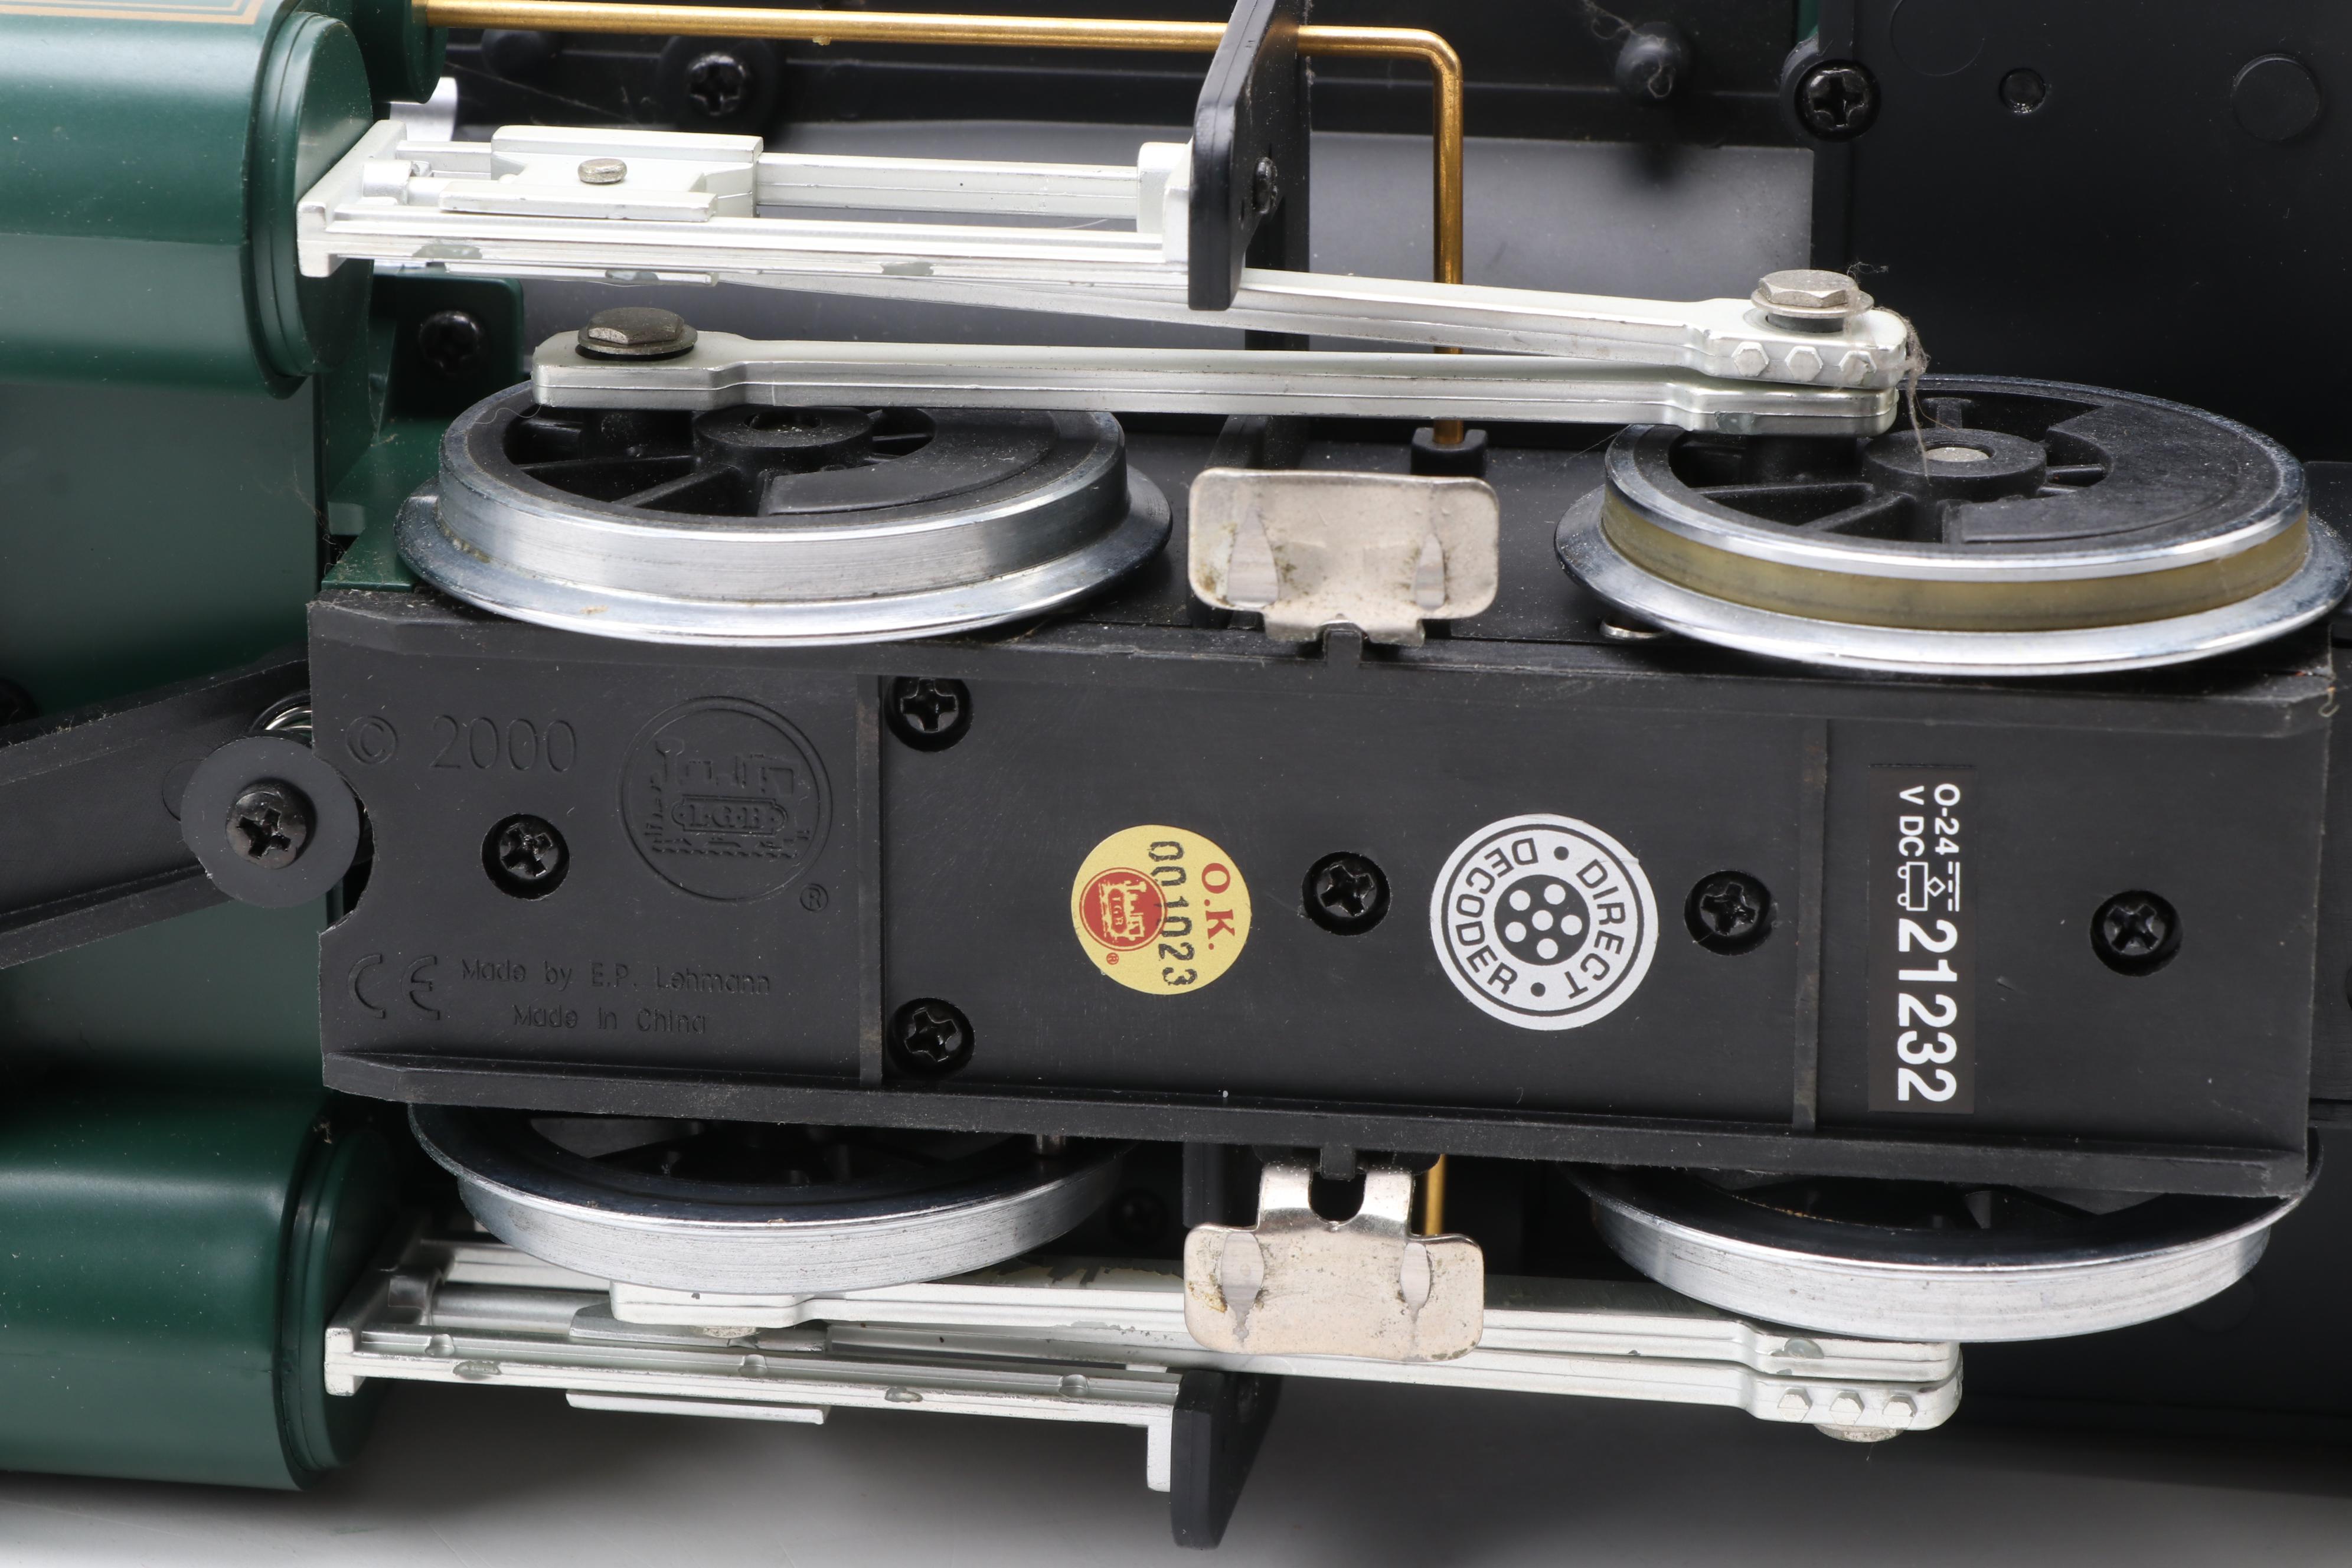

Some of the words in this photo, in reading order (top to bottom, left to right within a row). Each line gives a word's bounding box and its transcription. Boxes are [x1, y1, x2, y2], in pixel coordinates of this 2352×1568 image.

[429, 714, 577, 772] 2000
[1899, 786, 1925, 805] V
[1898, 816, 1925, 857] DC
[1148, 841, 1198, 986] 001023
[1201, 863, 1236, 950] O.K.
[1455, 837, 1539, 995] DECODER
[1564, 858, 1626, 999] DIRECT
[461, 958, 527, 982] Made
[543, 959, 573, 992] by
[655, 965, 770, 995] Lehmann
[1897, 918, 1958, 1102] 21232
[512, 1004, 579, 1029] Made
[637, 1008, 706, 1034] China
